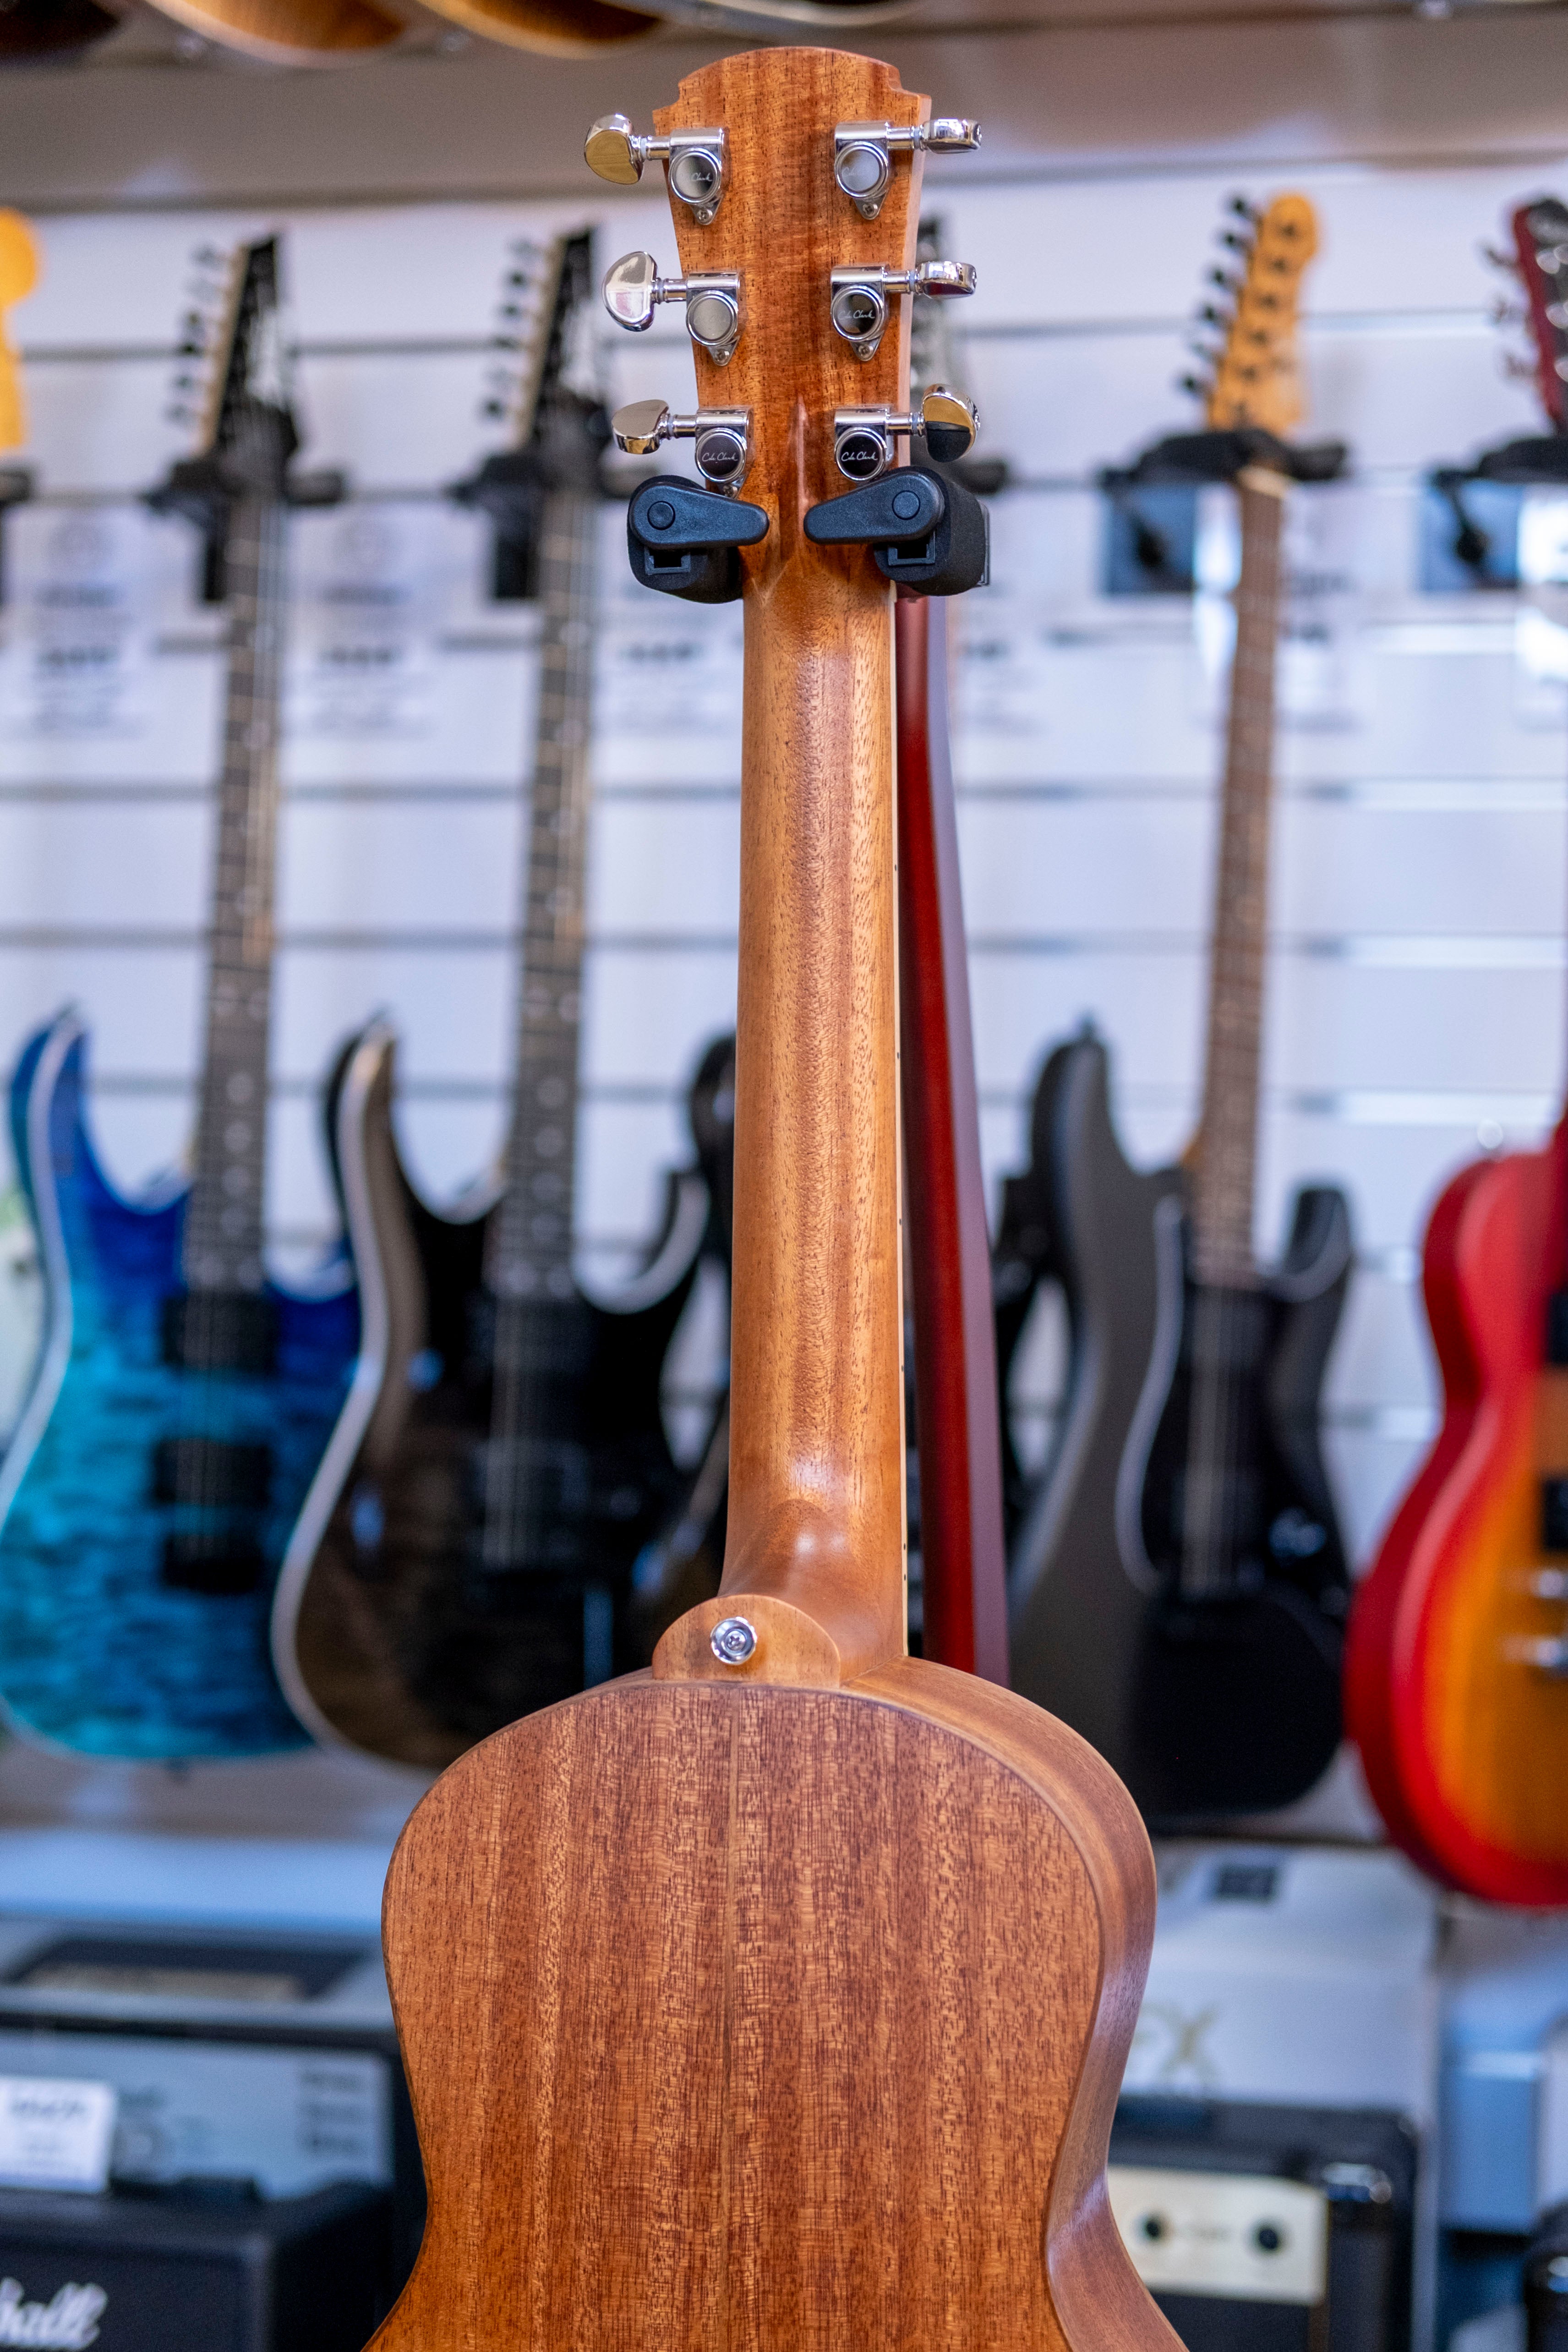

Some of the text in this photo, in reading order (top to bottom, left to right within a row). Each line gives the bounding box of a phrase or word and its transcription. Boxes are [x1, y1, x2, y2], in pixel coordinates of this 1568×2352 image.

[853, 310, 875, 319] Clark
[717, 452, 738, 461] Clark
[857, 451, 878, 460] Clark
